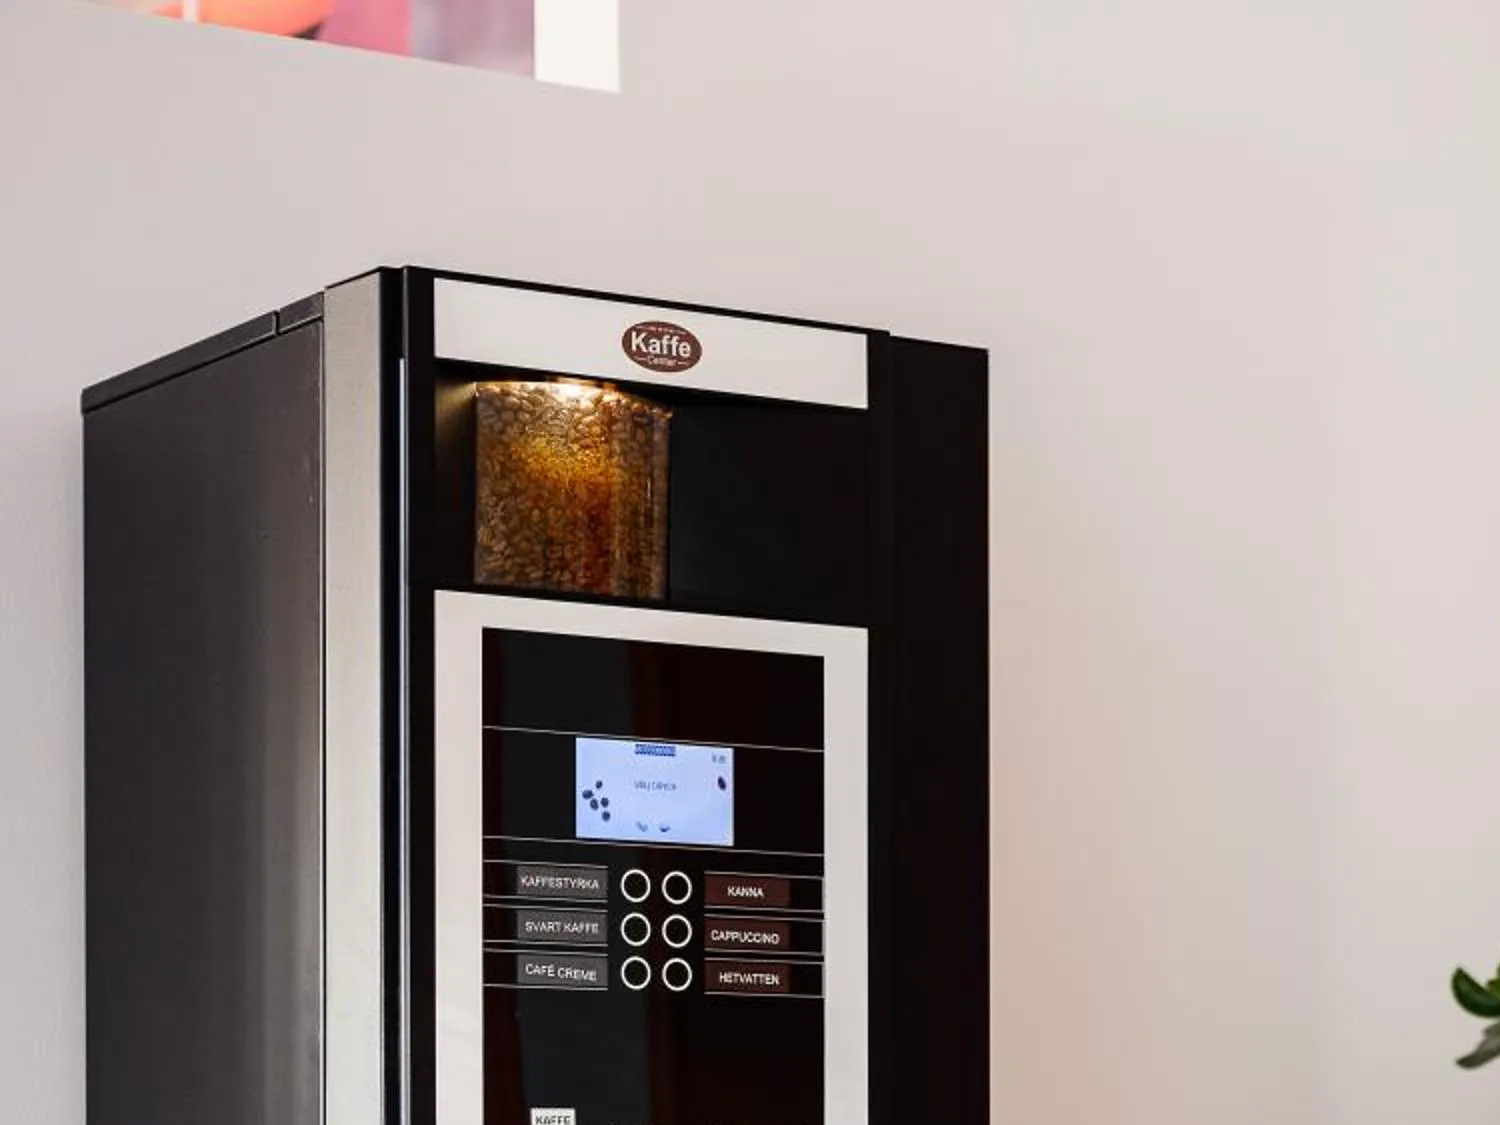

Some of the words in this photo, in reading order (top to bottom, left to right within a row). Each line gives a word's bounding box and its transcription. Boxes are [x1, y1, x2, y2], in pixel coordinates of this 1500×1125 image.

[631, 331, 692, 358] Kaffe
[520, 876, 599, 889] KAFFESTYRKA
[727, 886, 764, 898] KANNA
[525, 921, 560, 933] SVART
[711, 929, 780, 945] CAPPUCCINO
[719, 971, 780, 985] HETVATTEN
[535, 1115, 571, 1125] KAFFE
